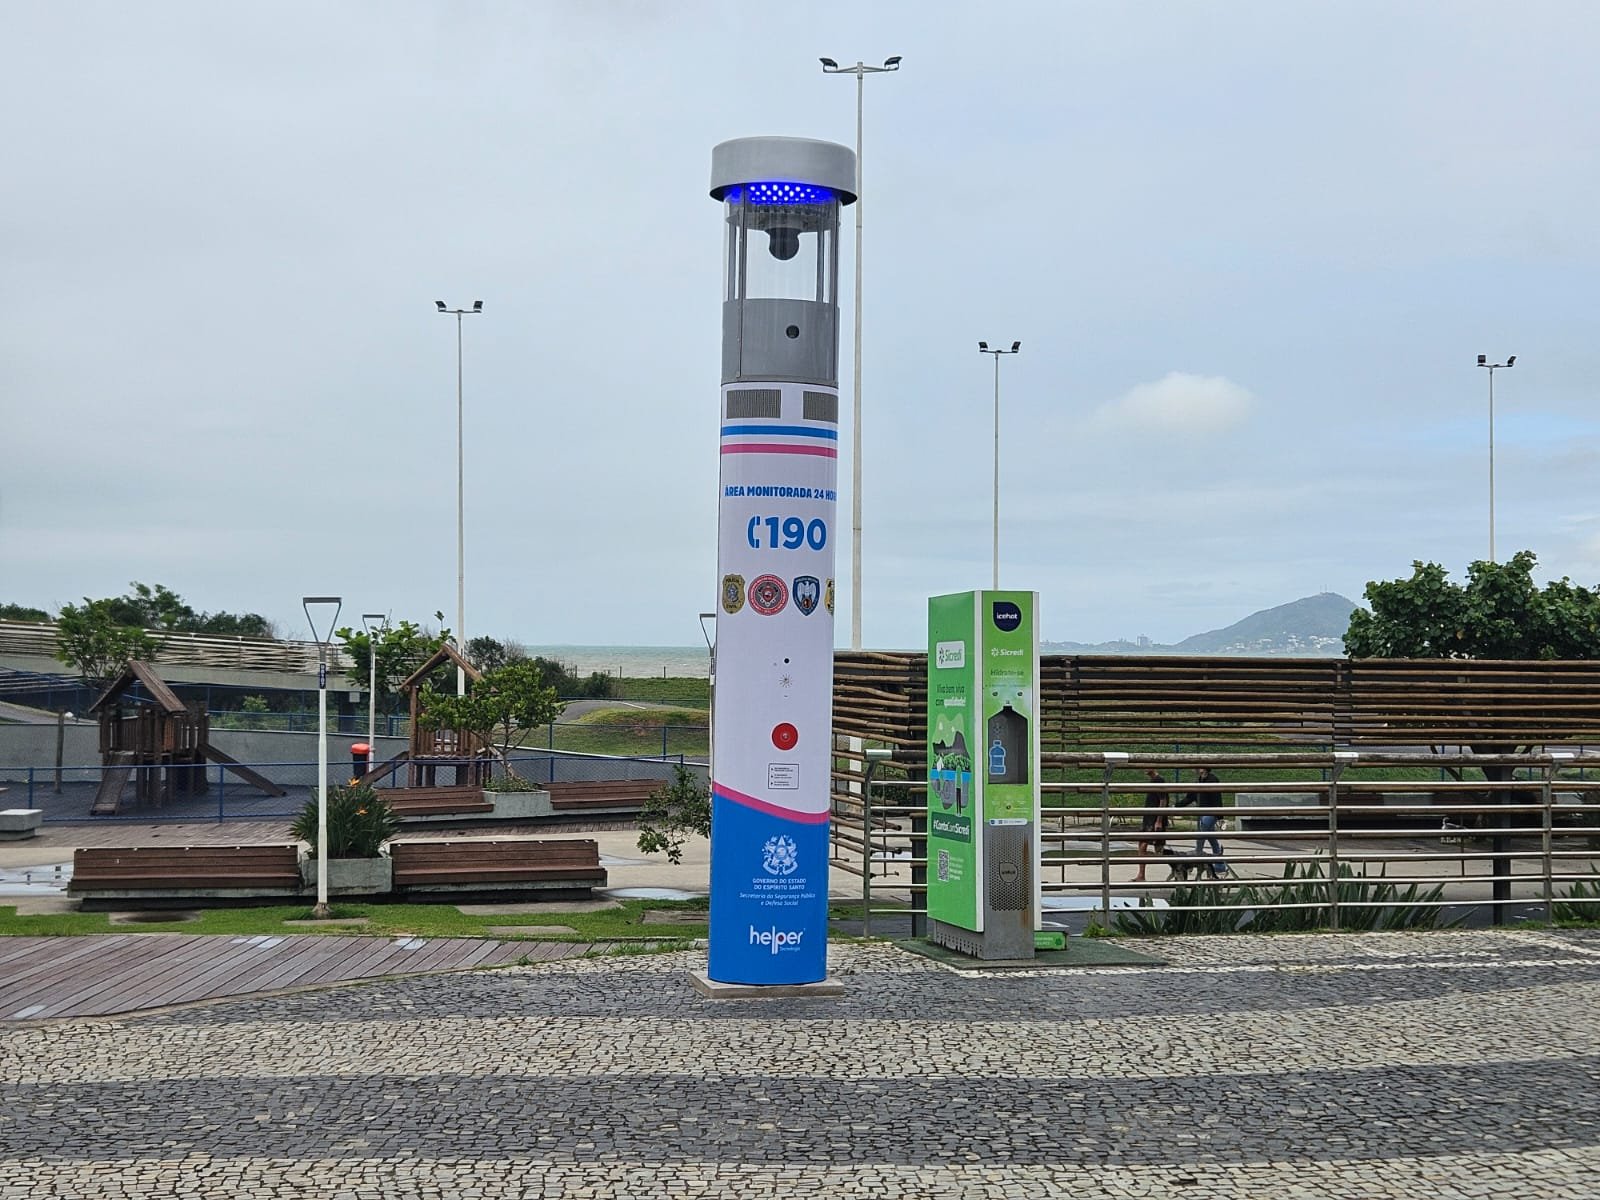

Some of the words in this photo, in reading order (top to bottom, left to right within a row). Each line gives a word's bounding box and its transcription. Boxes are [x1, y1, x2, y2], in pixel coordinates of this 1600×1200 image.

[747, 486, 812, 498] MONITORADA
[814, 489, 824, 499] 24
[765, 516, 827, 551] 190
[996, 612, 1018, 620] icehot
[945, 649, 962, 662] Sicredi
[999, 648, 1024, 656] Sicredi
[765, 899, 783, 907] Defesa
[749, 924, 804, 955] helper
